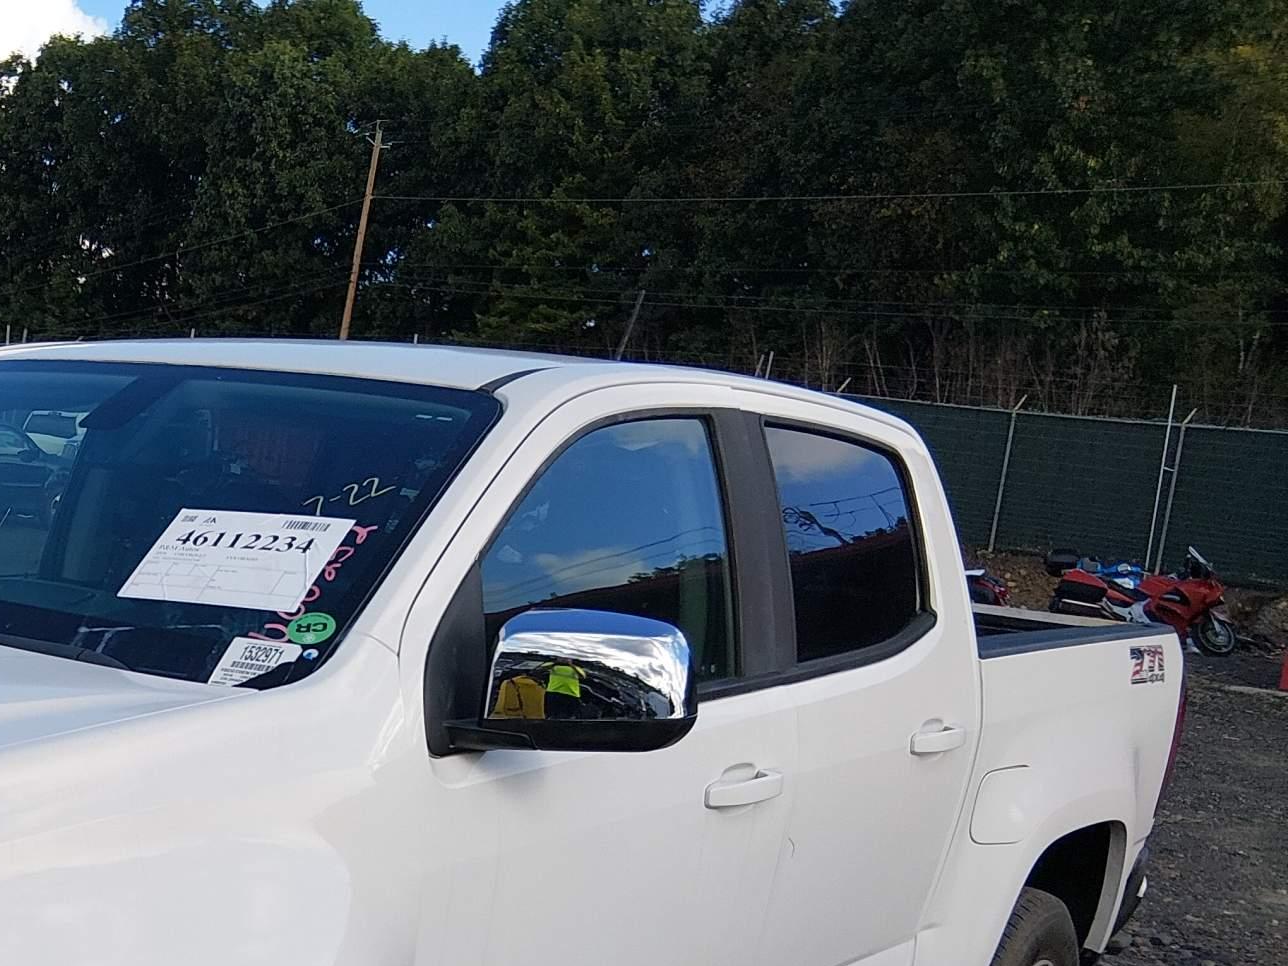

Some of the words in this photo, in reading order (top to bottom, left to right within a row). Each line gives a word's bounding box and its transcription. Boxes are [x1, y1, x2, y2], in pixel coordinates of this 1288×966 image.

[175, 529, 316, 554] 46112234
[295, 622, 328, 634] CR
[239, 645, 285, 665] 1532971
